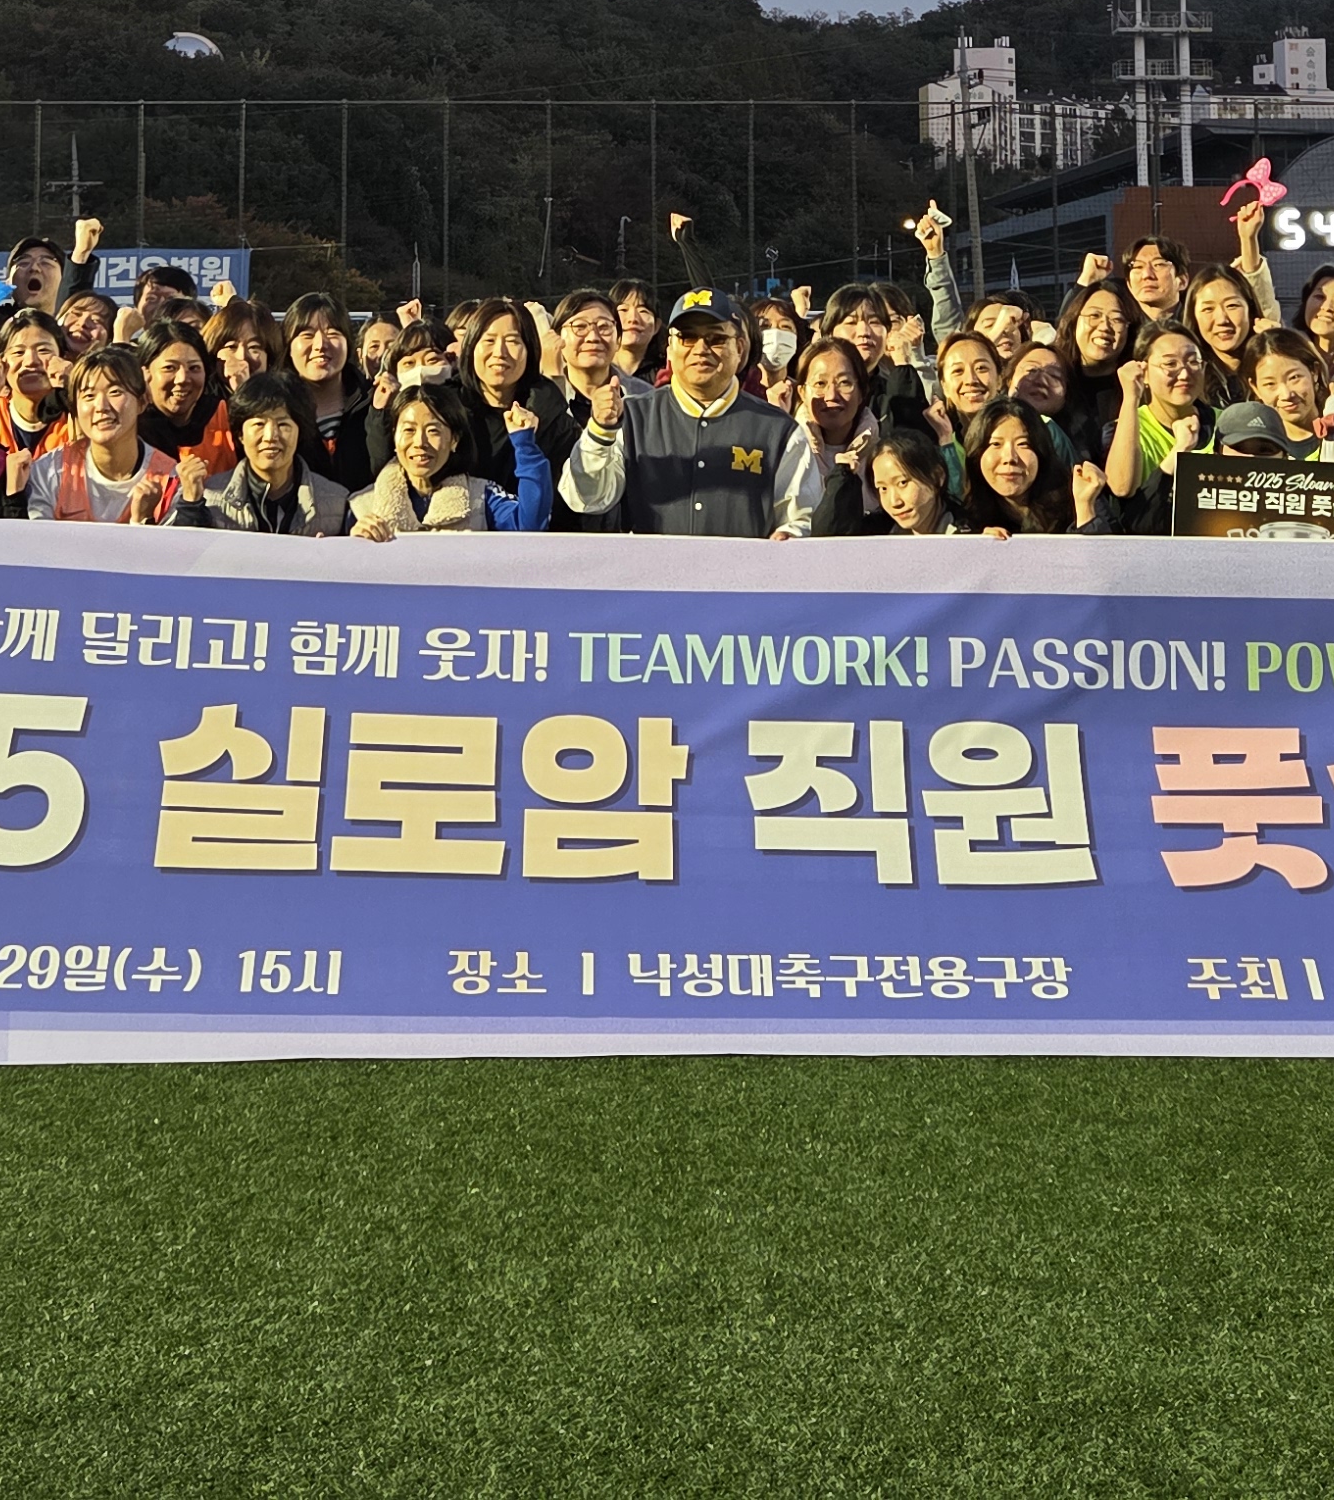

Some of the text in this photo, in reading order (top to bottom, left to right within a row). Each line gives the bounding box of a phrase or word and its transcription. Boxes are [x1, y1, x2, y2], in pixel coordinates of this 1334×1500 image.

[731, 445, 765, 475] M
[1244, 471, 1286, 490] 2025
[1197, 487, 1260, 513] 실로암
[1264, 491, 1307, 516] 직원
[81, 610, 269, 672] 달리고!
[290, 621, 400, 679] 함께
[418, 628, 549, 683] 웃자!
[568, 632, 930, 688] TEAMWORK!
[948, 637, 1227, 692] PASSION!
[153, 703, 690, 882] 실로암
[745, 720, 1099, 886] 직원
[238, 949, 343, 996] 15시
[447, 950, 547, 995] 장소
[628, 953, 1072, 999] 낙성대축구전용구장
[1187, 957, 1288, 1002] 주최
